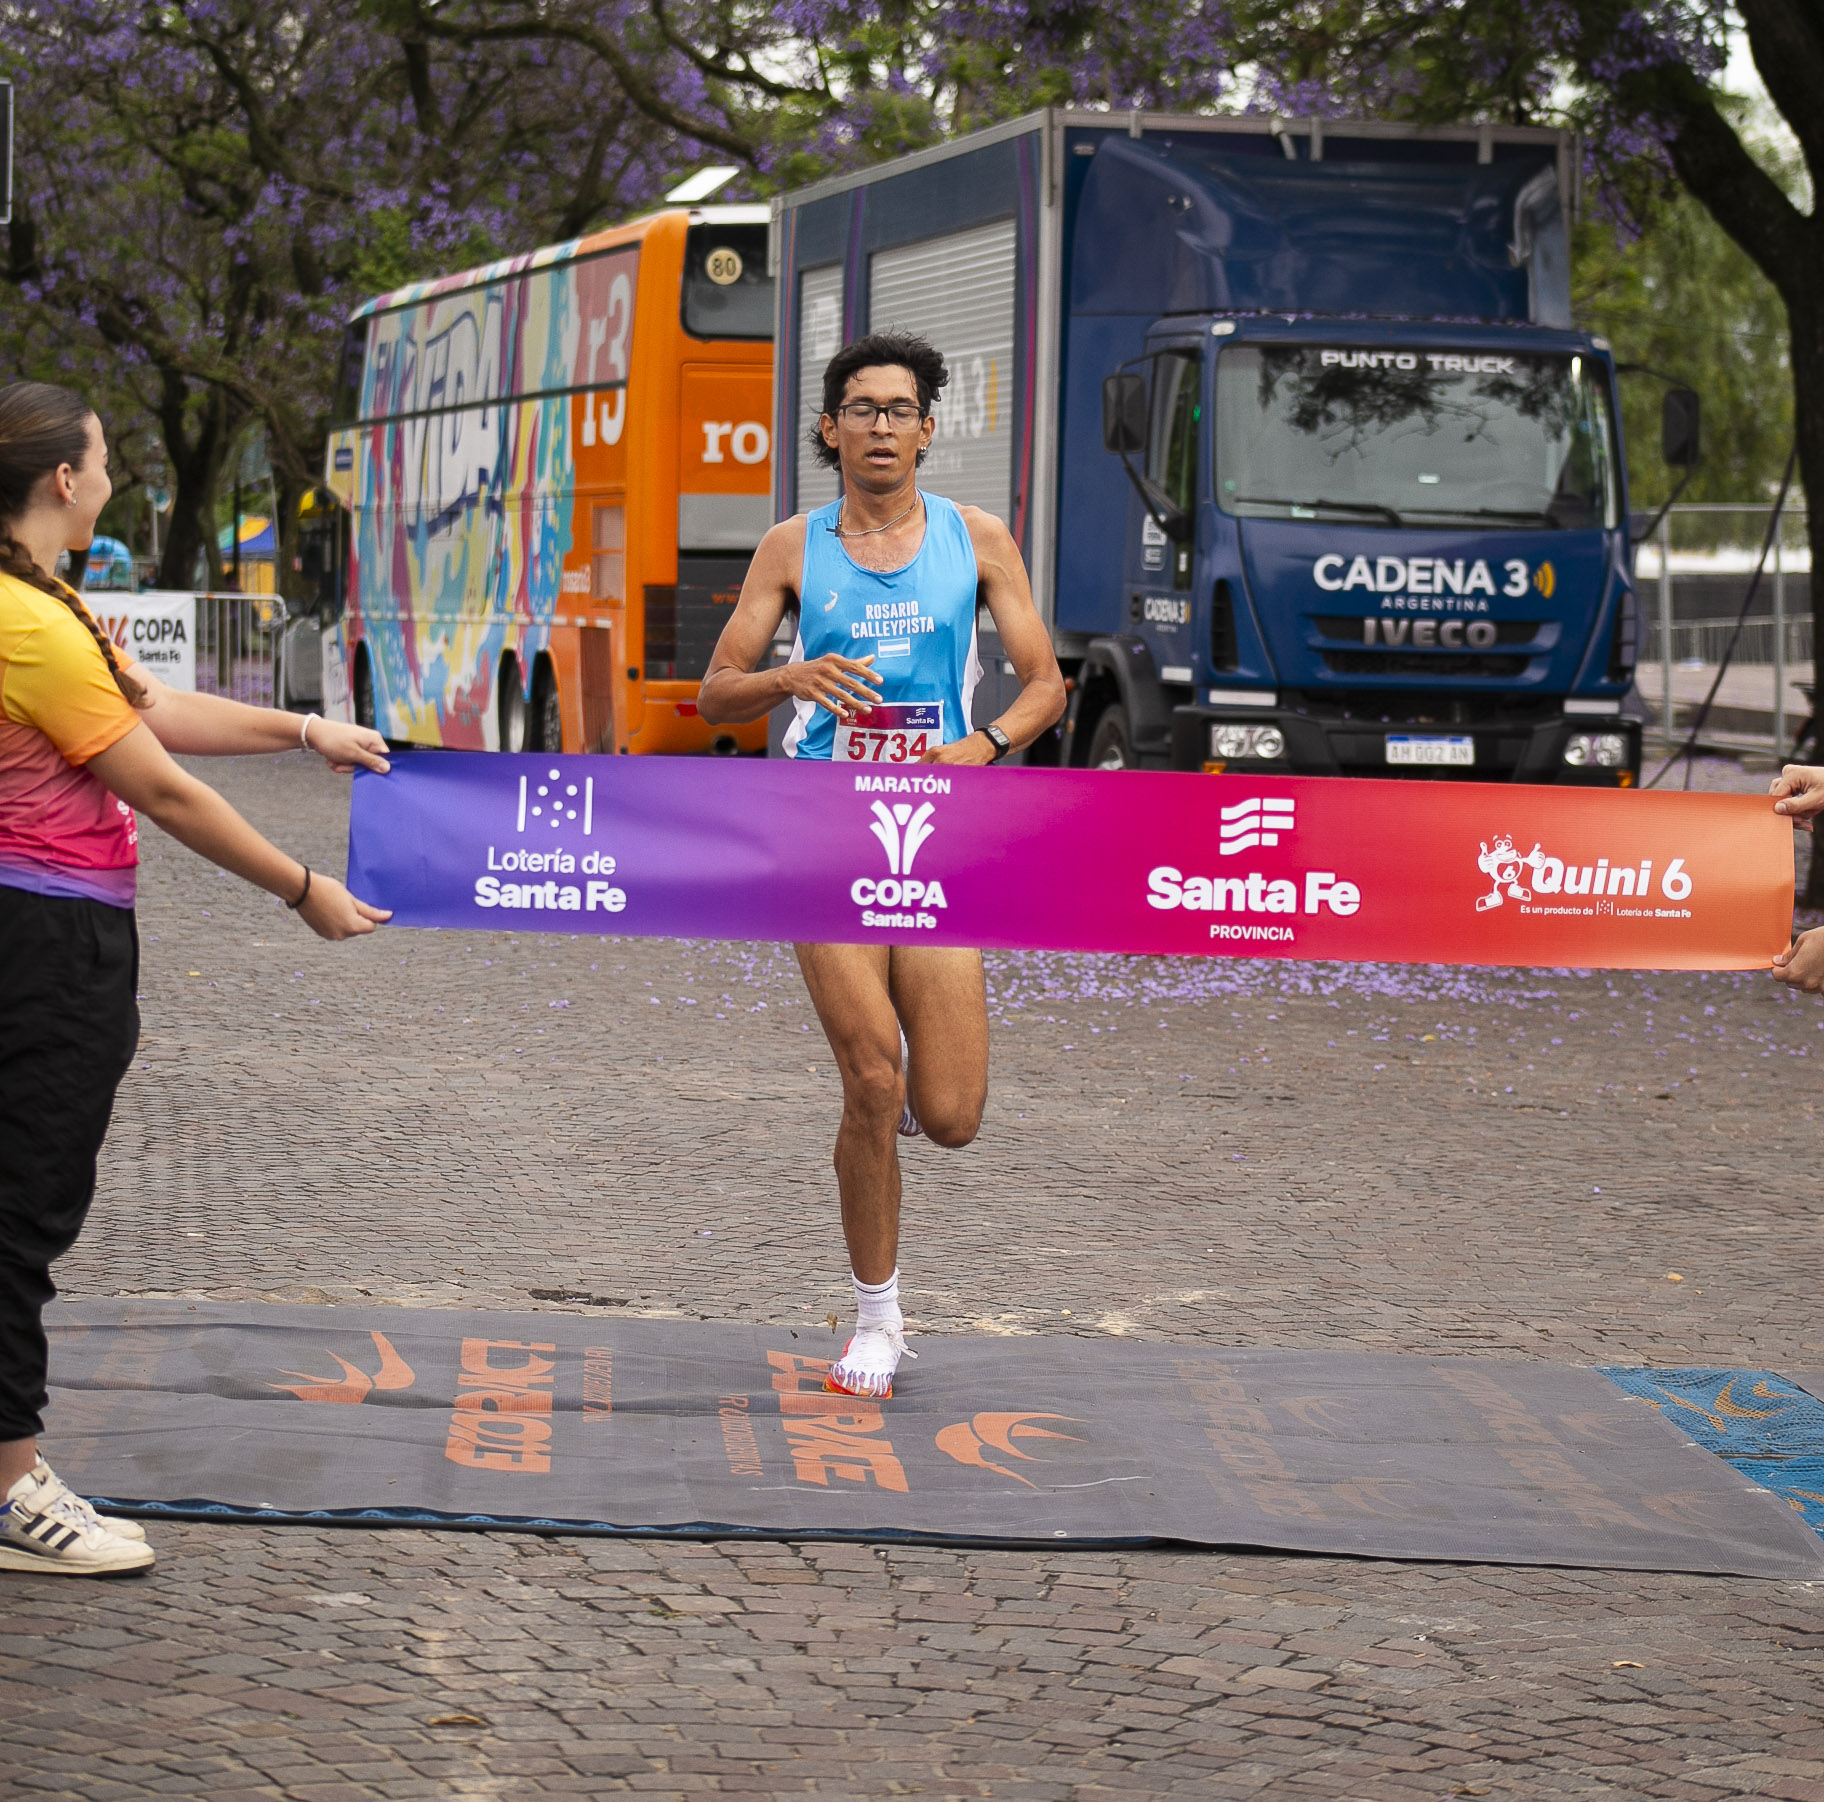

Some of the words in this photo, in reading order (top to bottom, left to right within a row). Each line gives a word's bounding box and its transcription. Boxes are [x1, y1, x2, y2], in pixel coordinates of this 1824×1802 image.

[712, 257, 737, 277] 80
[1320, 351, 1417, 370] PUNTO
[1426, 354, 1515, 374] TRUCK
[702, 421, 770, 464] ro
[1312, 553, 1497, 595] CADENA
[1502, 559, 1530, 598] 3
[865, 600, 919, 620] ROSARIO
[1380, 595, 1489, 612] ARGENTINA
[133, 618, 187, 643] COPA
[851, 616, 935, 639] CALLEYPISTA
[1362, 617, 1497, 649] IVECO
[138, 650, 168, 663] Santa
[927, 717, 935, 725] Fe
[847, 731, 927, 762] 5734
[855, 774, 951, 794] MARATÓN
[487, 846, 576, 873] Lotería
[581, 851, 617, 875] de
[1146, 866, 1297, 914] Santa
[1304, 872, 1361, 916] Fe
[1531, 857, 1653, 897] Quini
[1661, 858, 1693, 901] 6
[474, 876, 582, 911] Santa
[585, 880, 627, 912] Fe
[850, 878, 948, 909] COPA
[861, 910, 915, 928] Santa
[916, 912, 937, 929] Fe
[1520, 905, 1531, 914] Es
[1544, 906, 1582, 915] producto
[1582, 906, 1594, 915] de
[1616, 908, 1642, 917] Lotería
[1643, 908, 1653, 917] de
[1654, 909, 1681, 918] Santa
[1681, 909, 1692, 918] Fe
[1209, 924, 1295, 941] PROVINCIA
[767, 1350, 910, 1494] RACE
